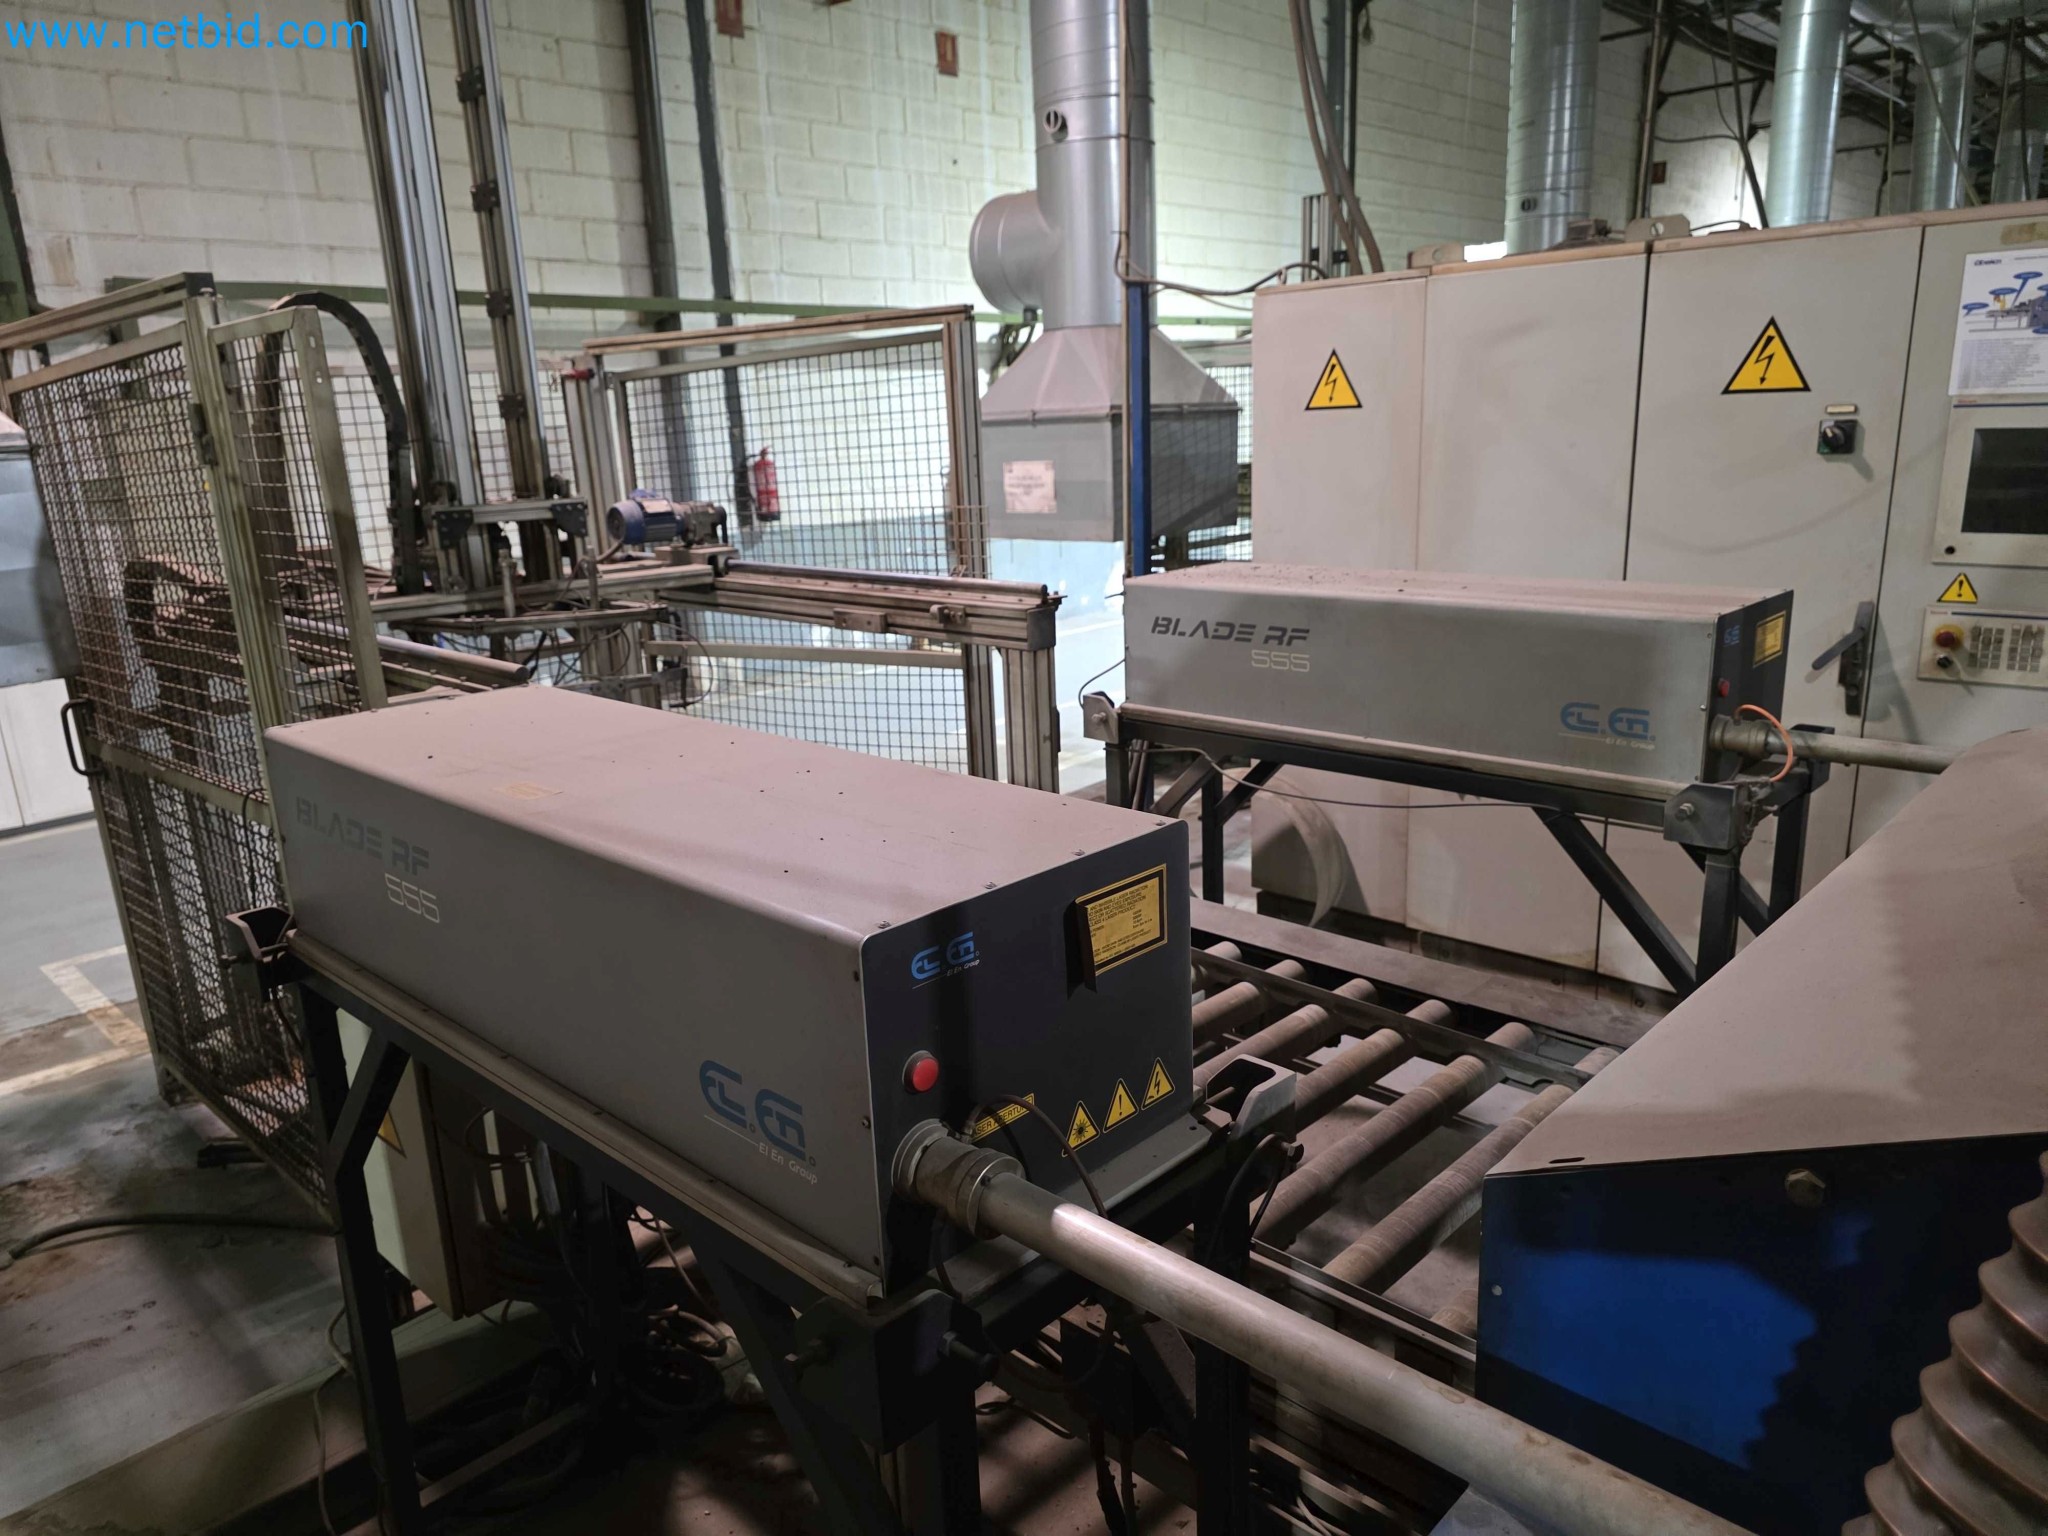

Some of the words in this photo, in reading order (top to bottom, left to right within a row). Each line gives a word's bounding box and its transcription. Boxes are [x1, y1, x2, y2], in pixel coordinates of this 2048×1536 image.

[1151, 616, 1257, 643] BLADE
[1262, 626, 1310, 647] RF
[297, 797, 383, 860] BLADE
[392, 836, 430, 876] RF
[789, 1160, 818, 1185] Group
